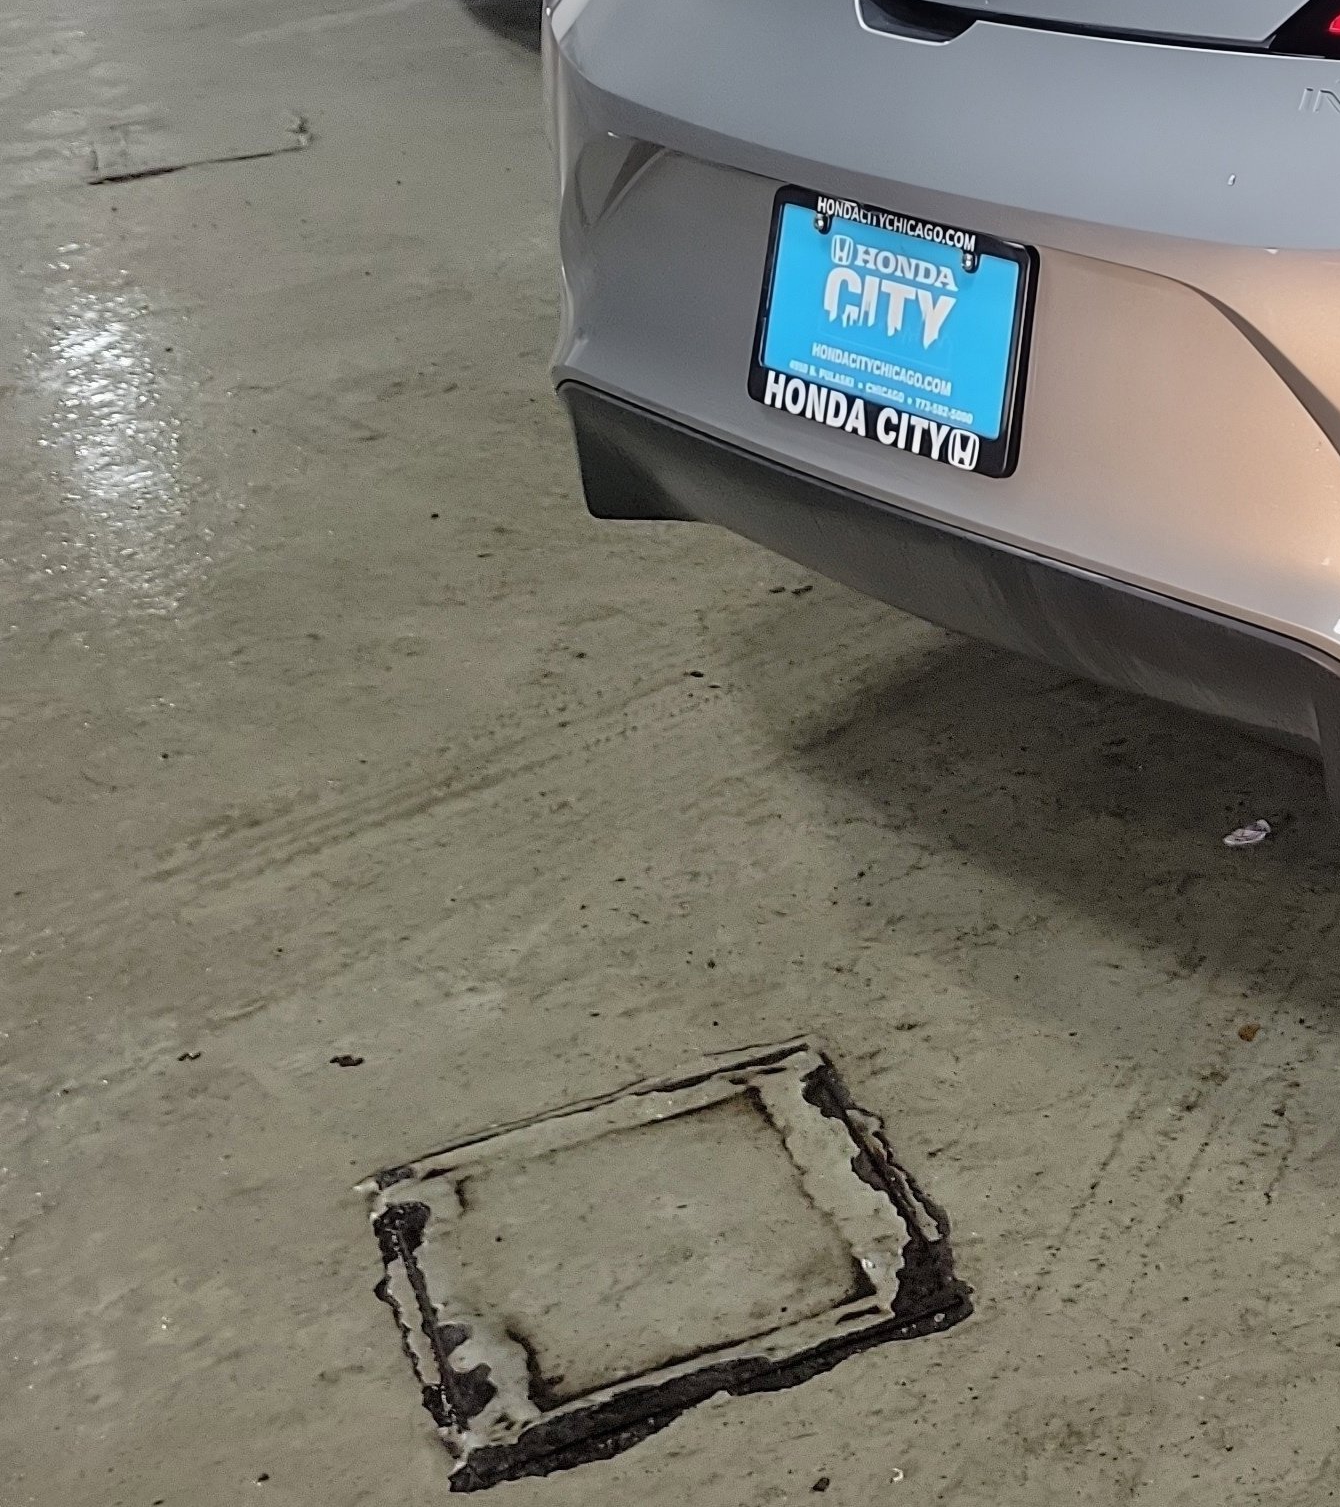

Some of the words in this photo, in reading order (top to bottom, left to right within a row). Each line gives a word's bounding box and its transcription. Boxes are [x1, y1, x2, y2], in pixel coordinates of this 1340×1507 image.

[855, 244, 959, 291] HONDA
[823, 267, 957, 350] CITY
[812, 342, 952, 396] HONDACITYCHICAGO.COM
[764, 370, 866, 437] HONDA
[876, 407, 952, 461] CITY
